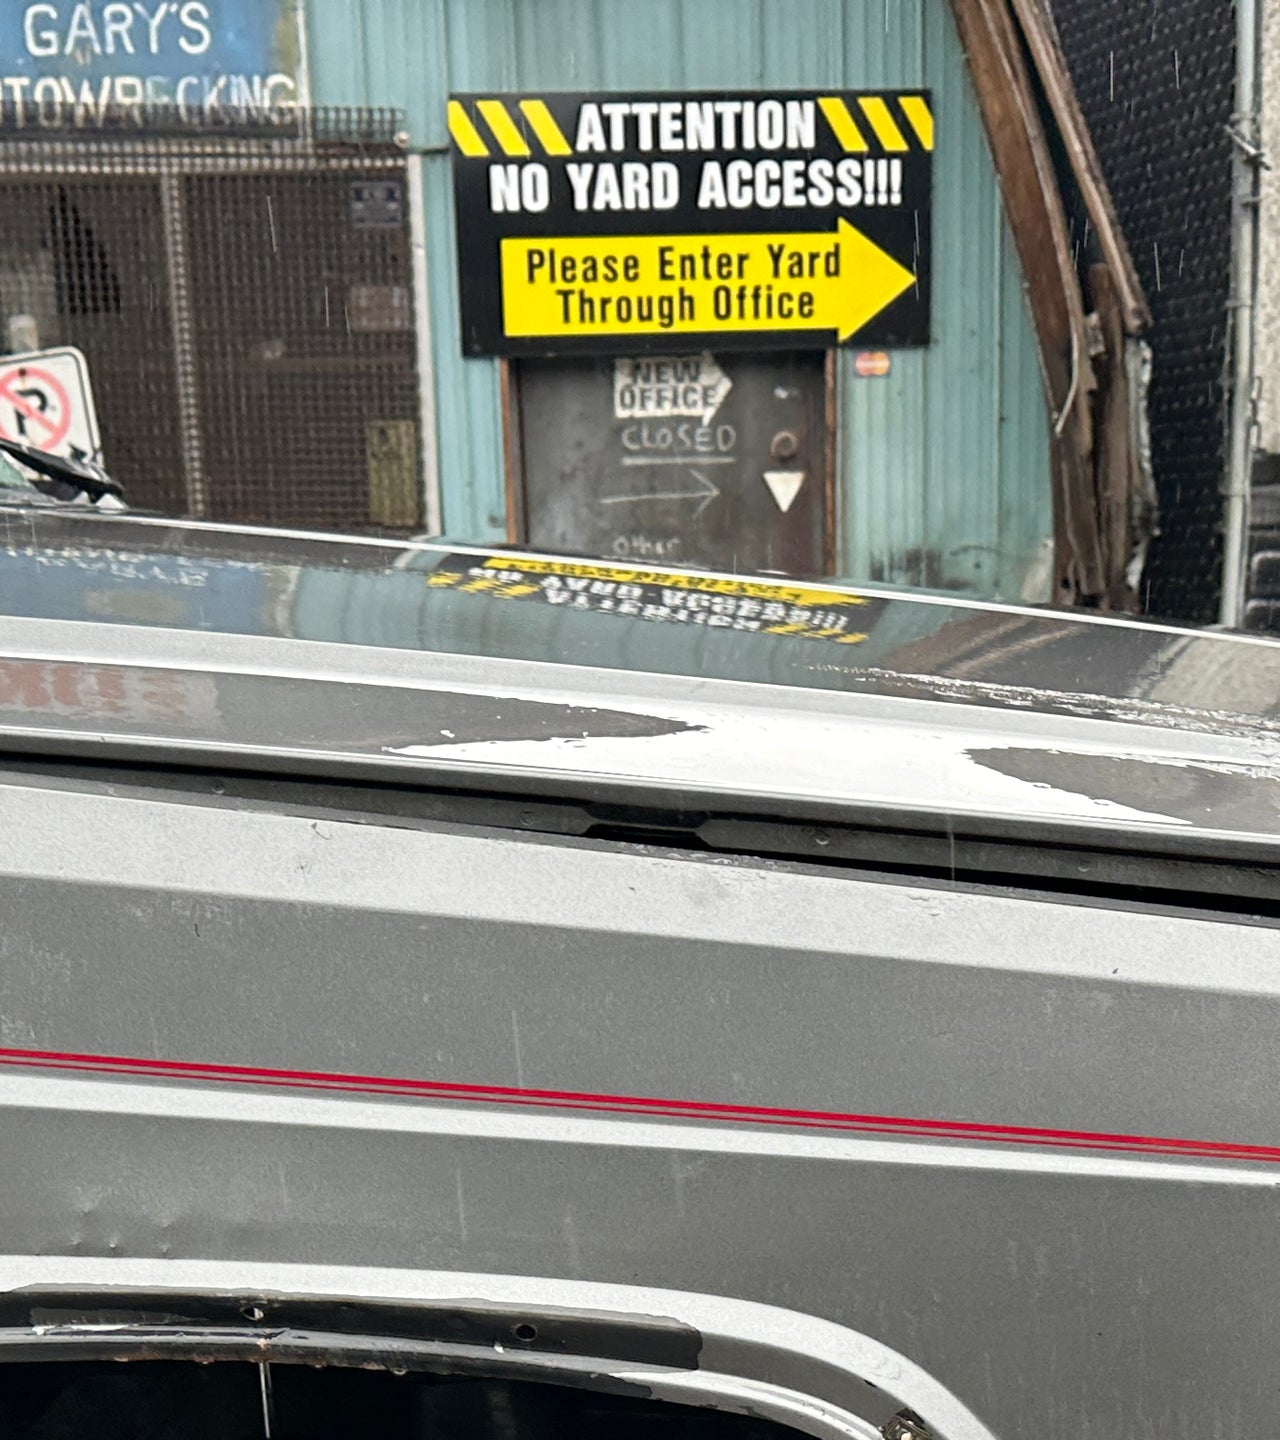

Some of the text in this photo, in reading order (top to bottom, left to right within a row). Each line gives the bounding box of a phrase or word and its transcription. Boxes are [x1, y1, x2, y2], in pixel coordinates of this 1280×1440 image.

[24, 2, 211, 56] GARY'S
[575, 101, 816, 154] ATTENTION
[489, 157, 902, 213] NO YARD ACCESS!!!
[527, 242, 841, 284] Please Enter Yard
[554, 285, 815, 328] Through Office
[632, 360, 702, 383] NEW
[620, 383, 718, 409] OFFICE
[622, 424, 737, 452] CLOSED
